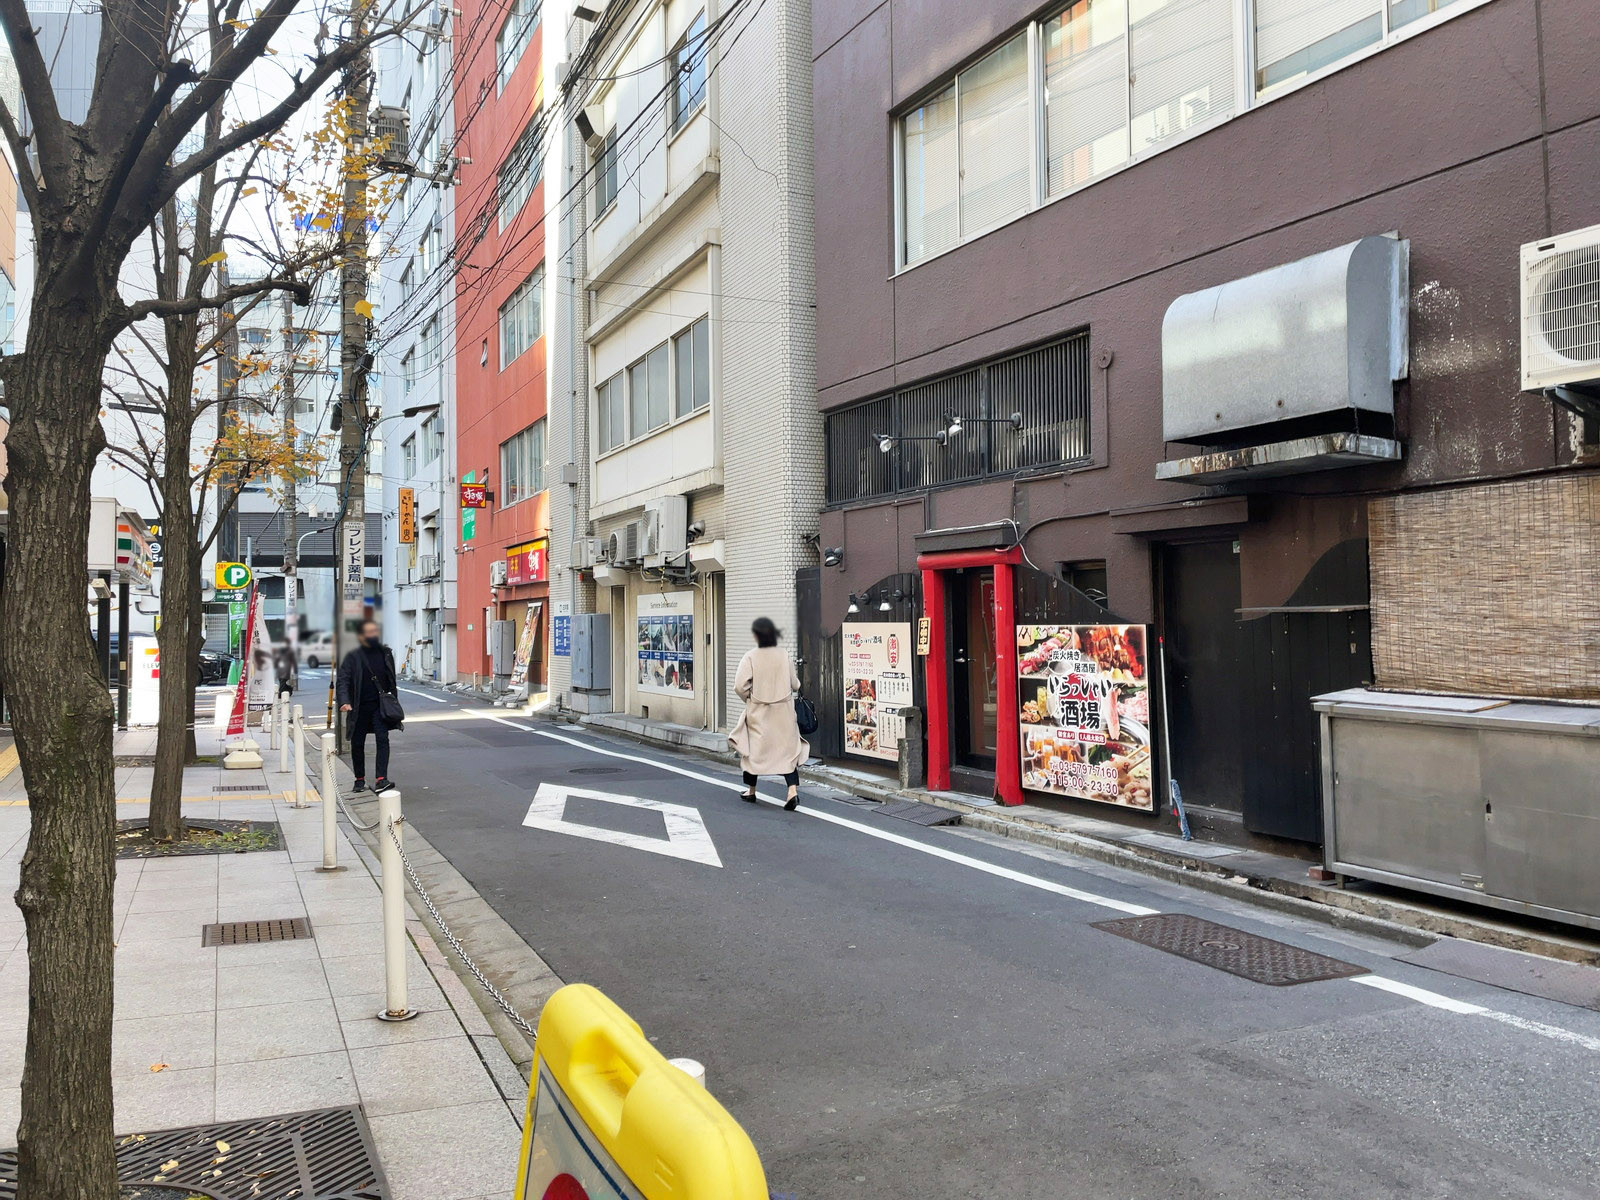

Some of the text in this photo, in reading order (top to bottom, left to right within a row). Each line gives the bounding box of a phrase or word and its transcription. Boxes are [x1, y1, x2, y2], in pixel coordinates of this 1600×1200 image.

[348, 529, 361, 583] フレンド薬局
[231, 568, 246, 584] P
[1053, 650, 1080, 660] 炭火焼き
[1074, 663, 1095, 673] 居酒屋
[1049, 676, 1112, 697] いらっしゃい
[1061, 701, 1100, 728] 酒場
